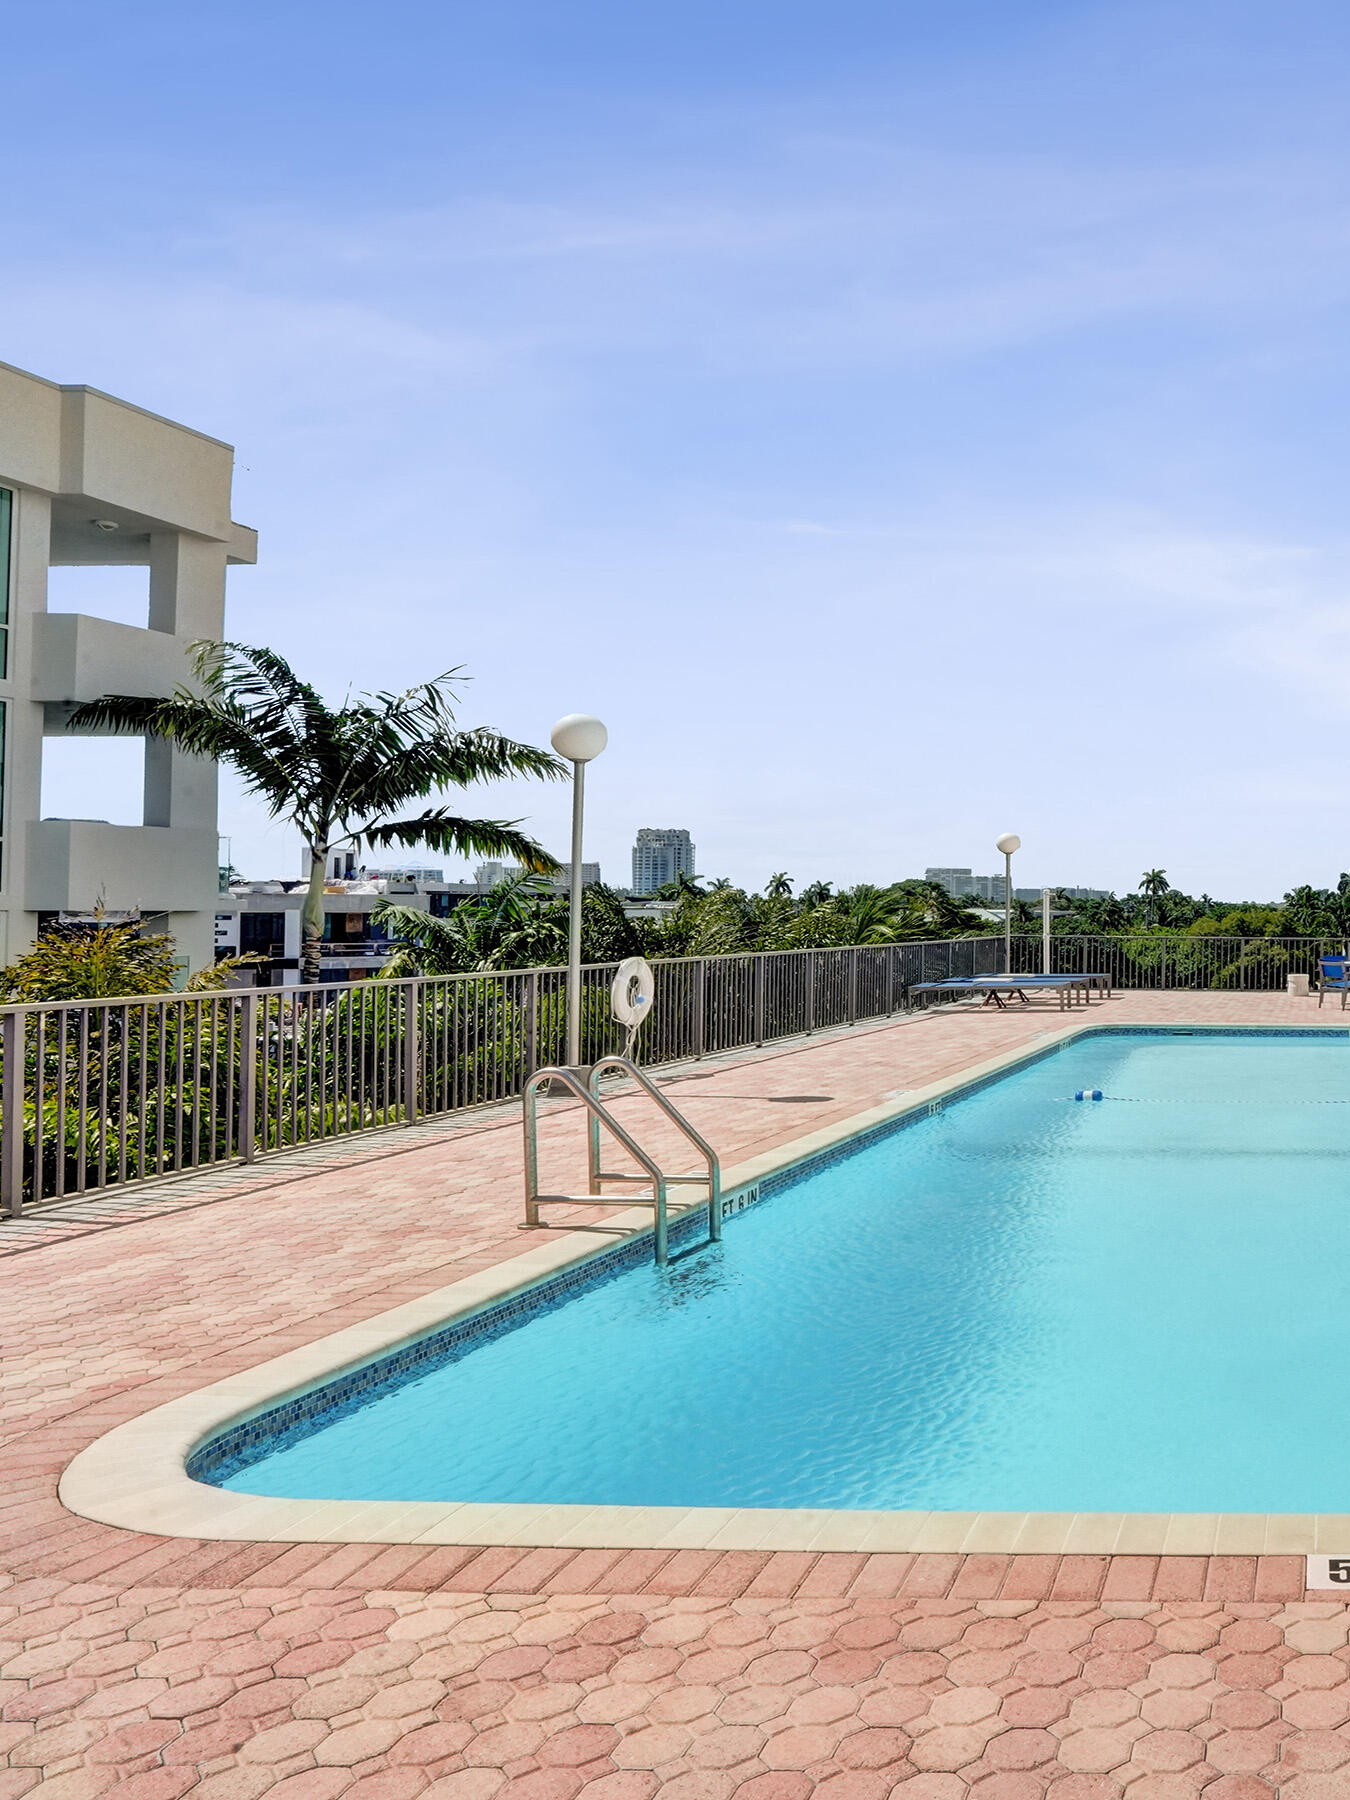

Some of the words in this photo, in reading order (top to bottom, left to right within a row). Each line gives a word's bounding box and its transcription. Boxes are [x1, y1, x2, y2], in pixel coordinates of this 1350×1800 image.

[722, 1198, 734, 1217] FT
[738, 1195, 744, 1209] 6
[748, 1188, 757, 1205] IN
